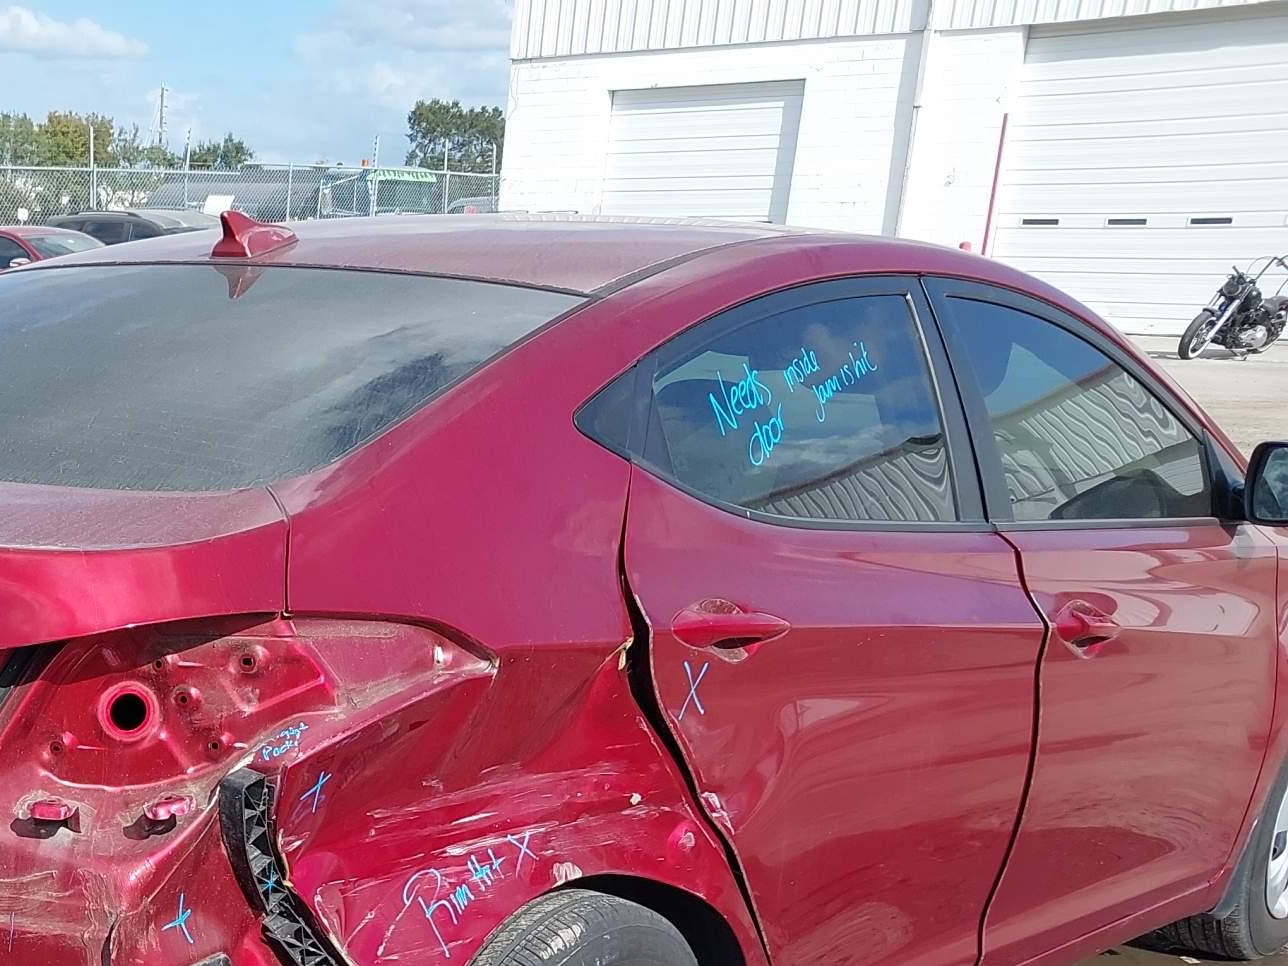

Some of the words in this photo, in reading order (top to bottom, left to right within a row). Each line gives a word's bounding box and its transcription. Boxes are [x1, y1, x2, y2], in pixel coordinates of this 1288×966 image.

[709, 363, 772, 436] Needs
[784, 347, 820, 393] inside
[749, 402, 784, 466] door
